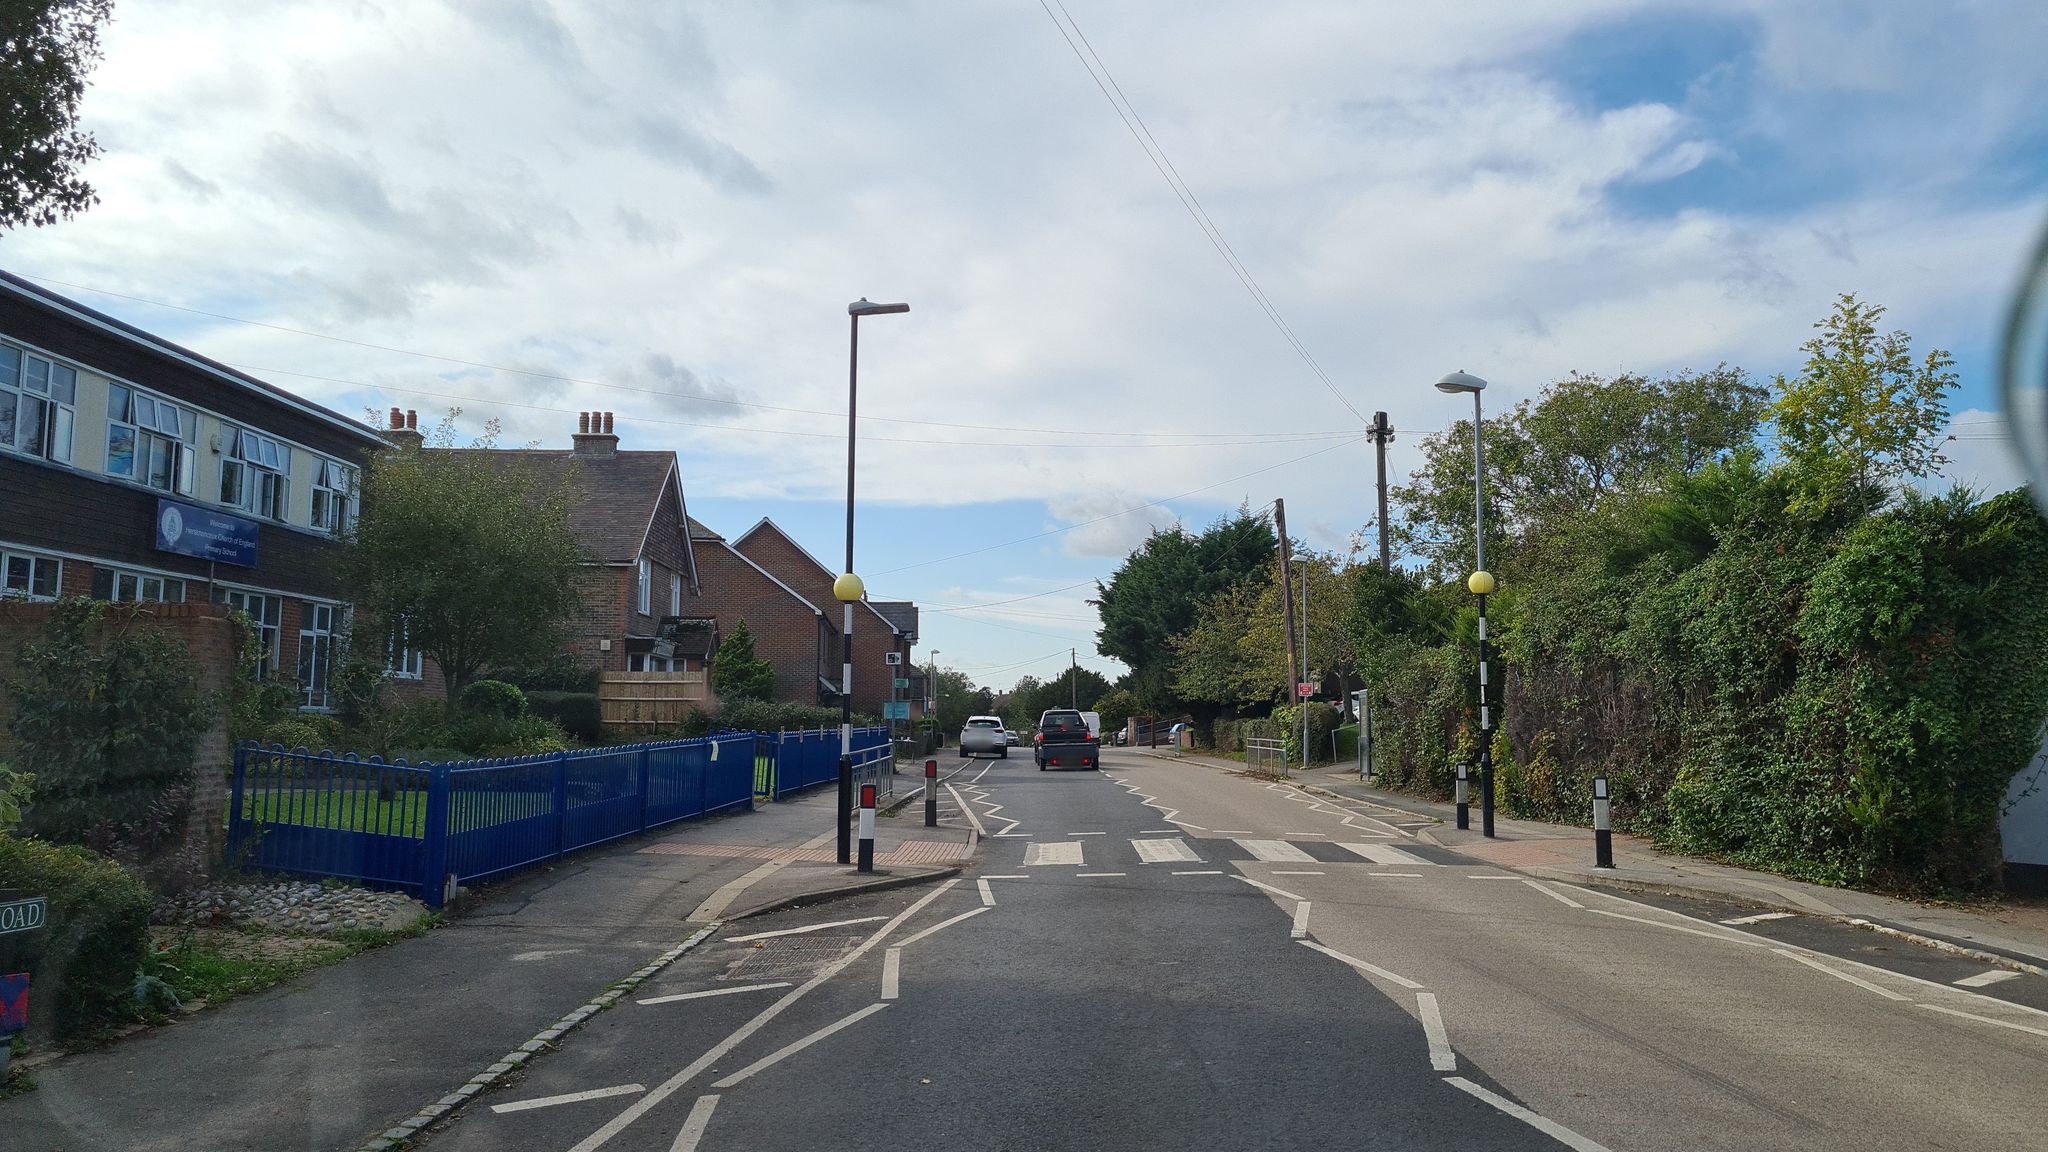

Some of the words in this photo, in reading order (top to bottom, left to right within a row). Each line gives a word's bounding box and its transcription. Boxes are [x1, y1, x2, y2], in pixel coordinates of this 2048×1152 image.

[210, 519, 230, 529] Welcome
[217, 533, 233, 543] Church
[239, 538, 256, 549] England
[205, 544, 221, 556] Primary
[222, 547, 237, 557] School
[1, 904, 39, 929] OAD
